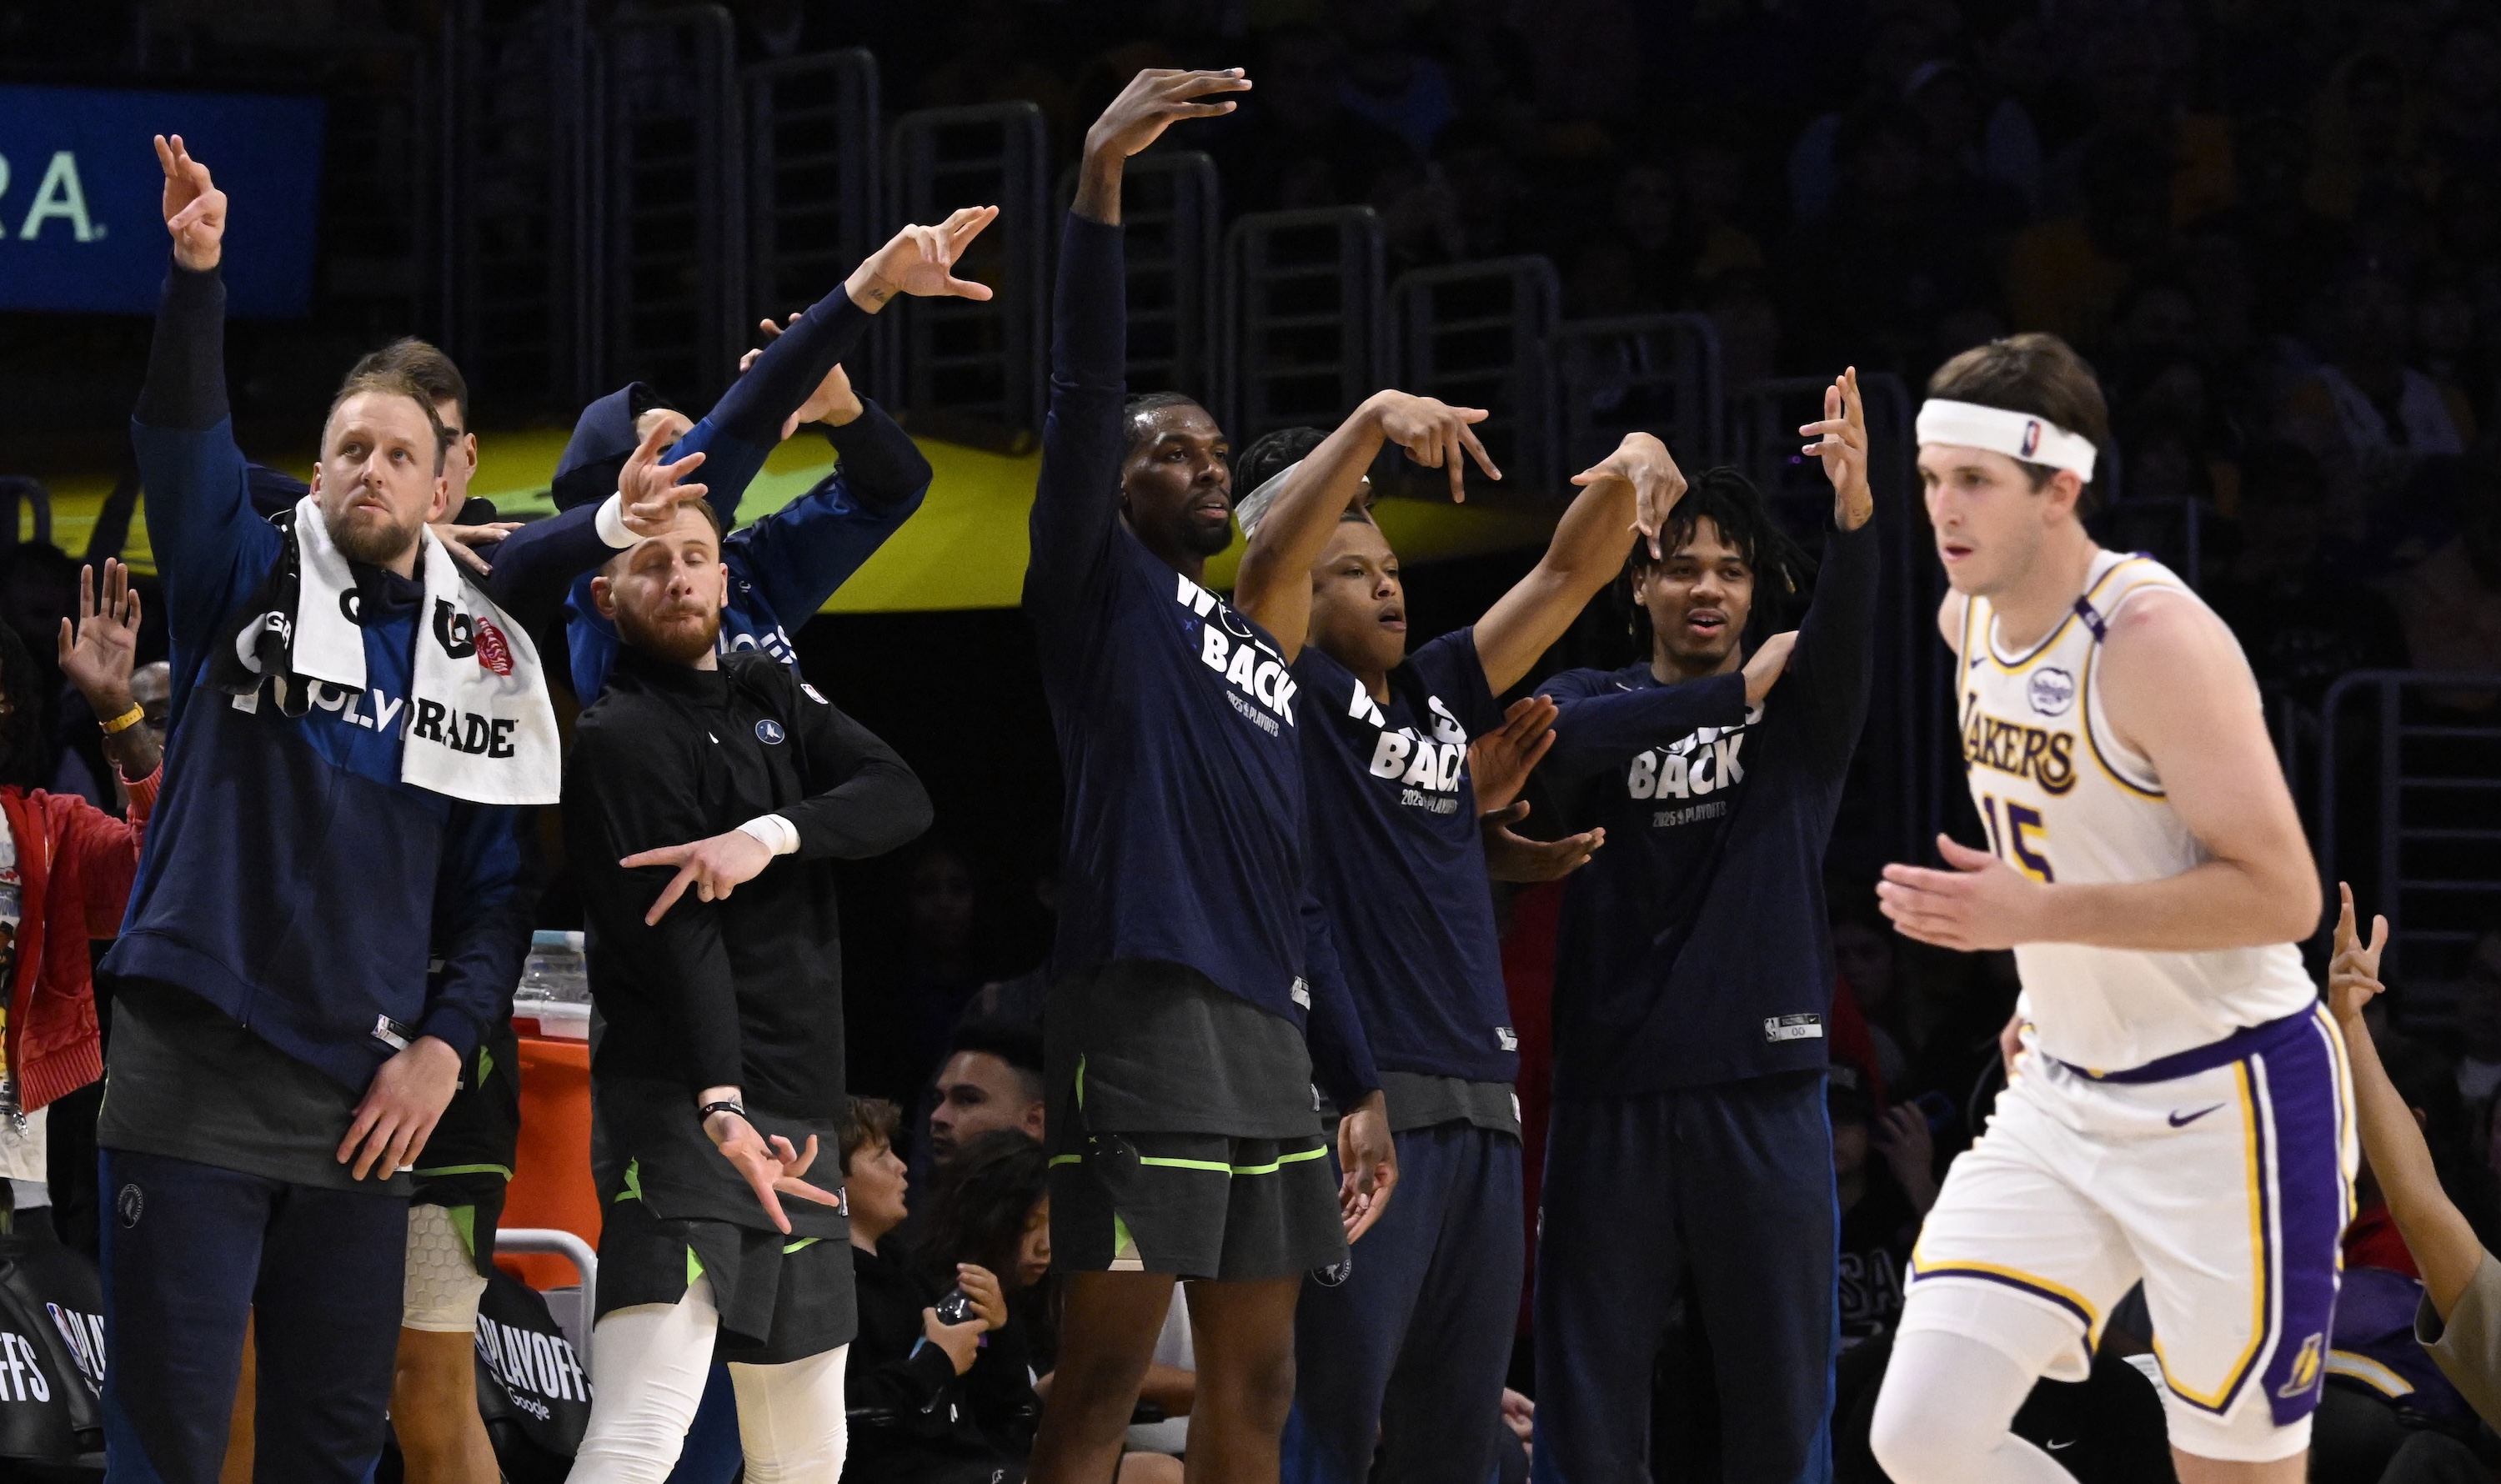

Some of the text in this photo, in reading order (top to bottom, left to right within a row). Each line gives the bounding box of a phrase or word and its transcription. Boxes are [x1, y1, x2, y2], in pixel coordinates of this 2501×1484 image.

[1200, 623, 1298, 728] BACK
[1249, 705, 1280, 738] PLAYOFFS
[1369, 730, 1467, 792] BACK
[1627, 732, 1745, 800] BACK
[1401, 789, 1424, 806] 2025
[1652, 800, 1727, 827] 2025 PLAYOFFS
[1983, 795, 2054, 884] 15
[476, 1311, 593, 1403] PLAYOFF
[507, 1386, 551, 1421] Google
